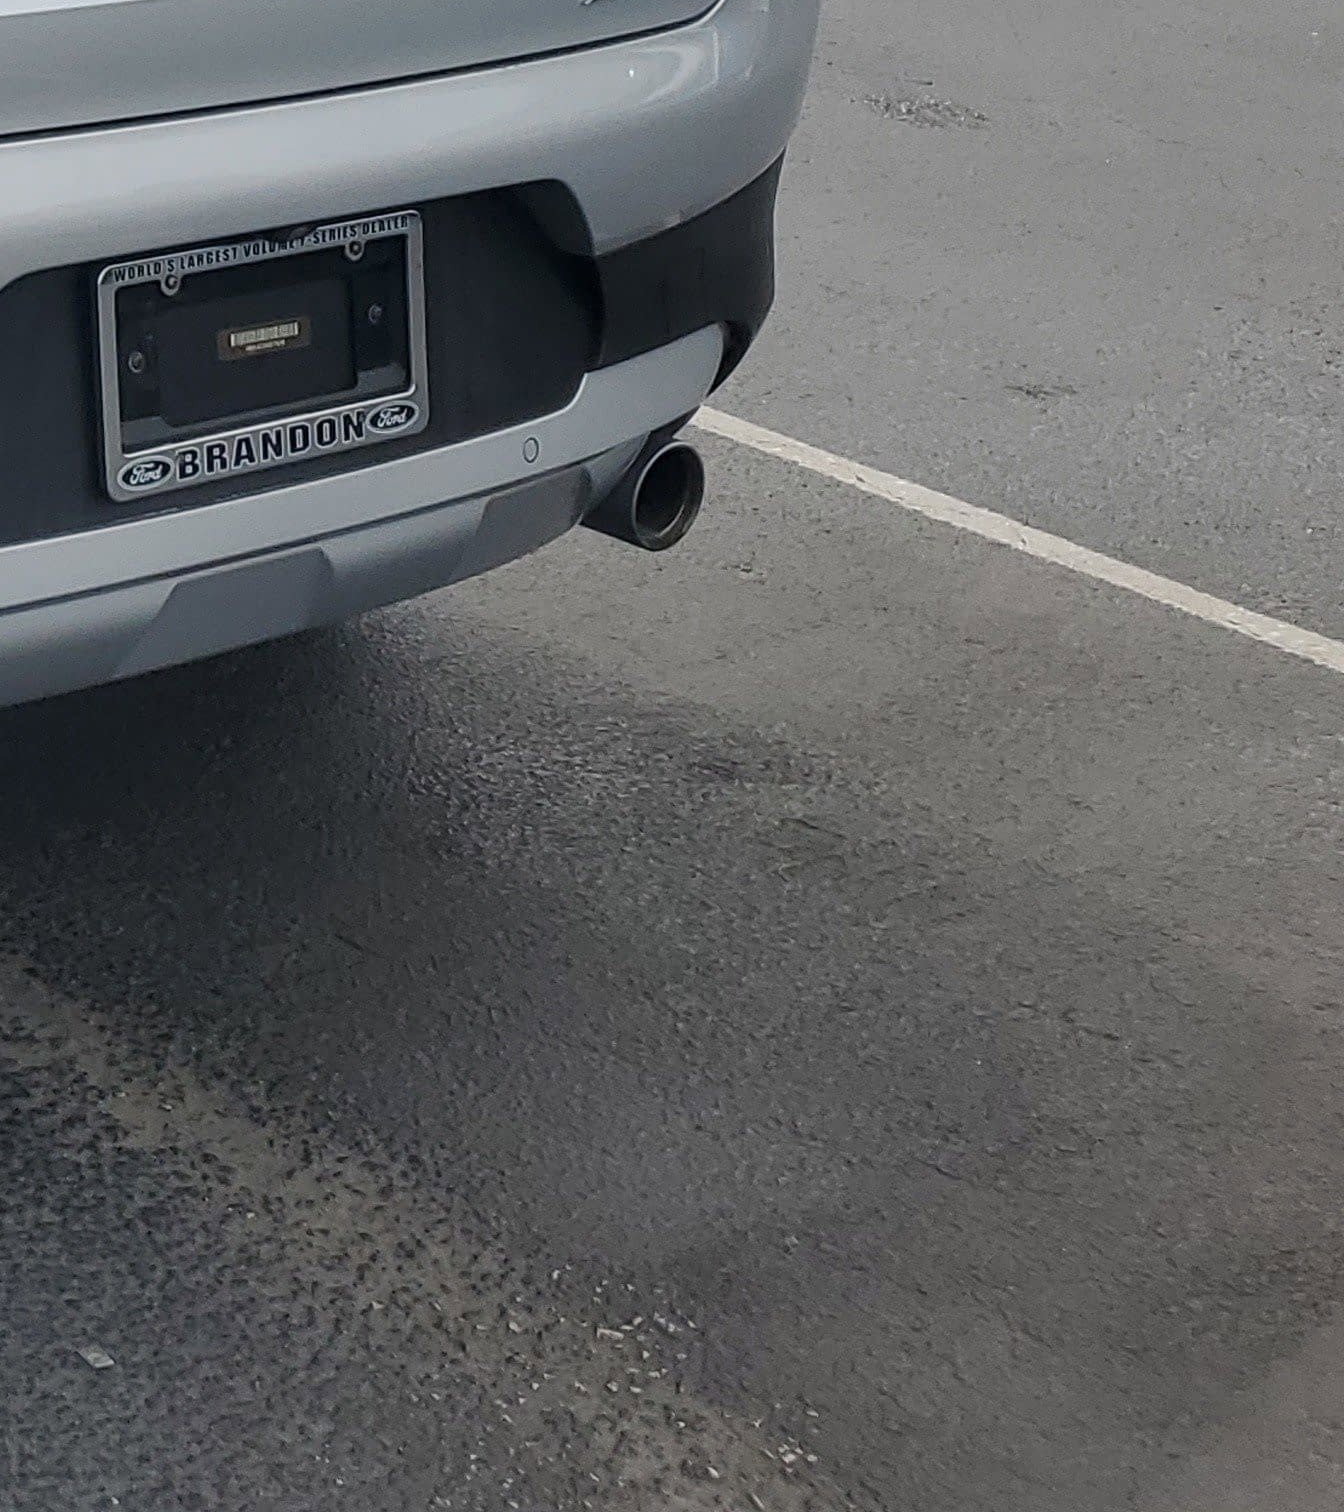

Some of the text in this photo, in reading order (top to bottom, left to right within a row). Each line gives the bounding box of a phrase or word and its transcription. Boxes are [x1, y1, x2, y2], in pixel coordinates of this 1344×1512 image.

[180, 247, 239, 270] LARGEST
[360, 215, 410, 236] DEALER
[376, 406, 408, 429] Ford
[176, 411, 366, 481] BRANDON
[129, 461, 163, 485] Ford
